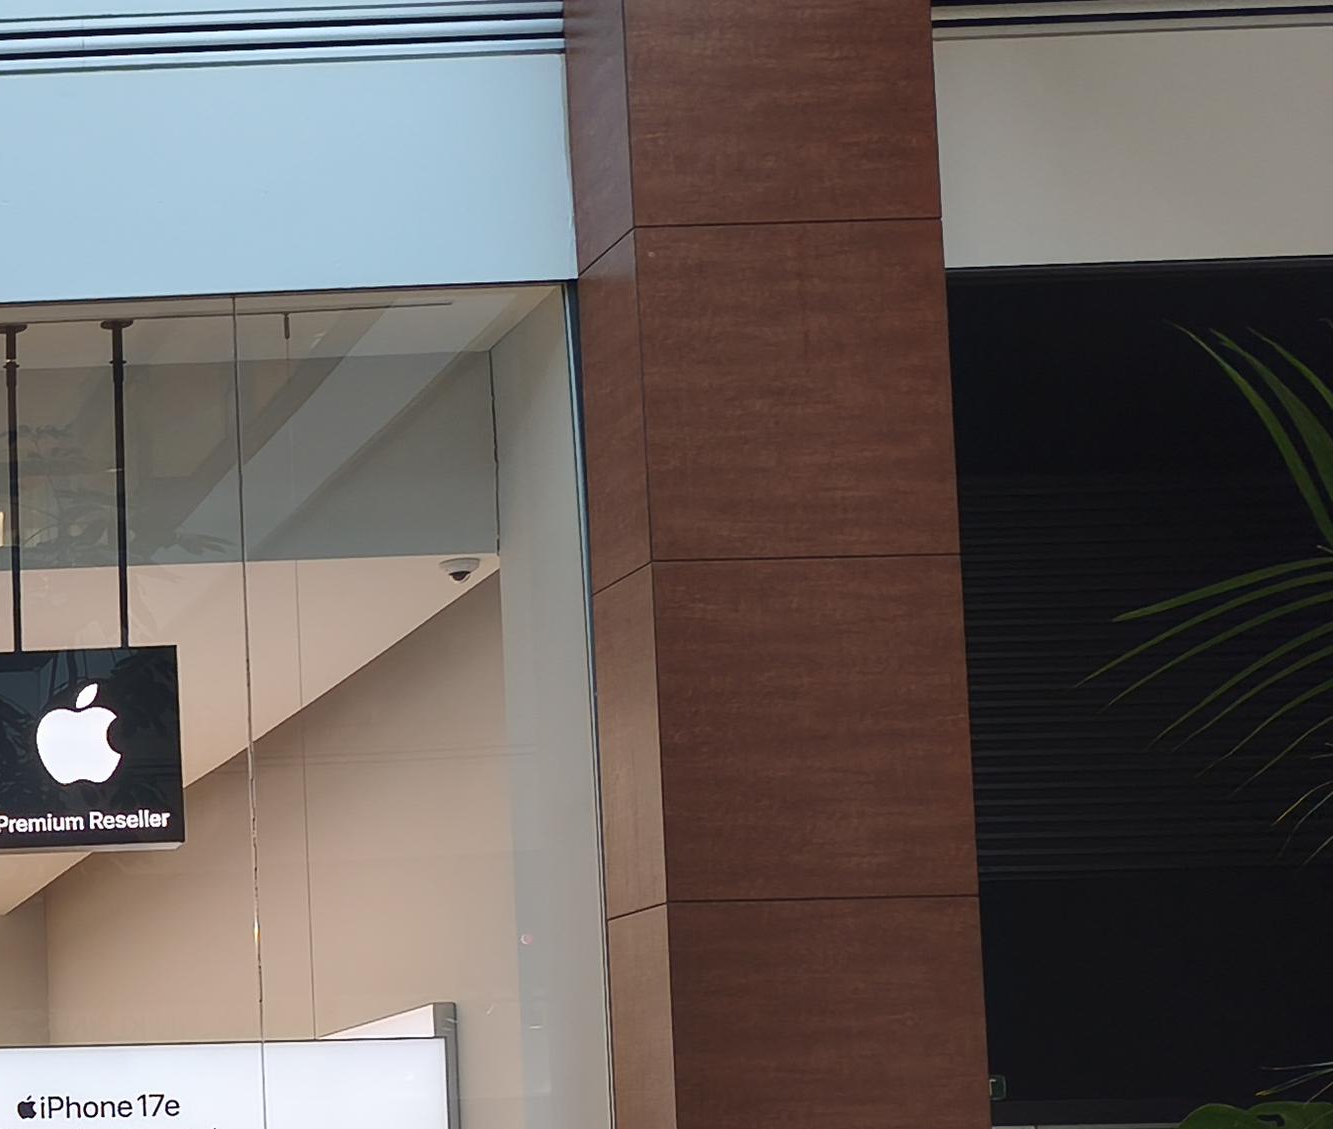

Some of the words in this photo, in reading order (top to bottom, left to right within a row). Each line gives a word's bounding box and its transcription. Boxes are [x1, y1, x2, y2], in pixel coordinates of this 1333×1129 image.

[89, 809, 171, 830] Reseller
[40, 1095, 133, 1119] iPhone
[136, 1094, 181, 1117] 17e
